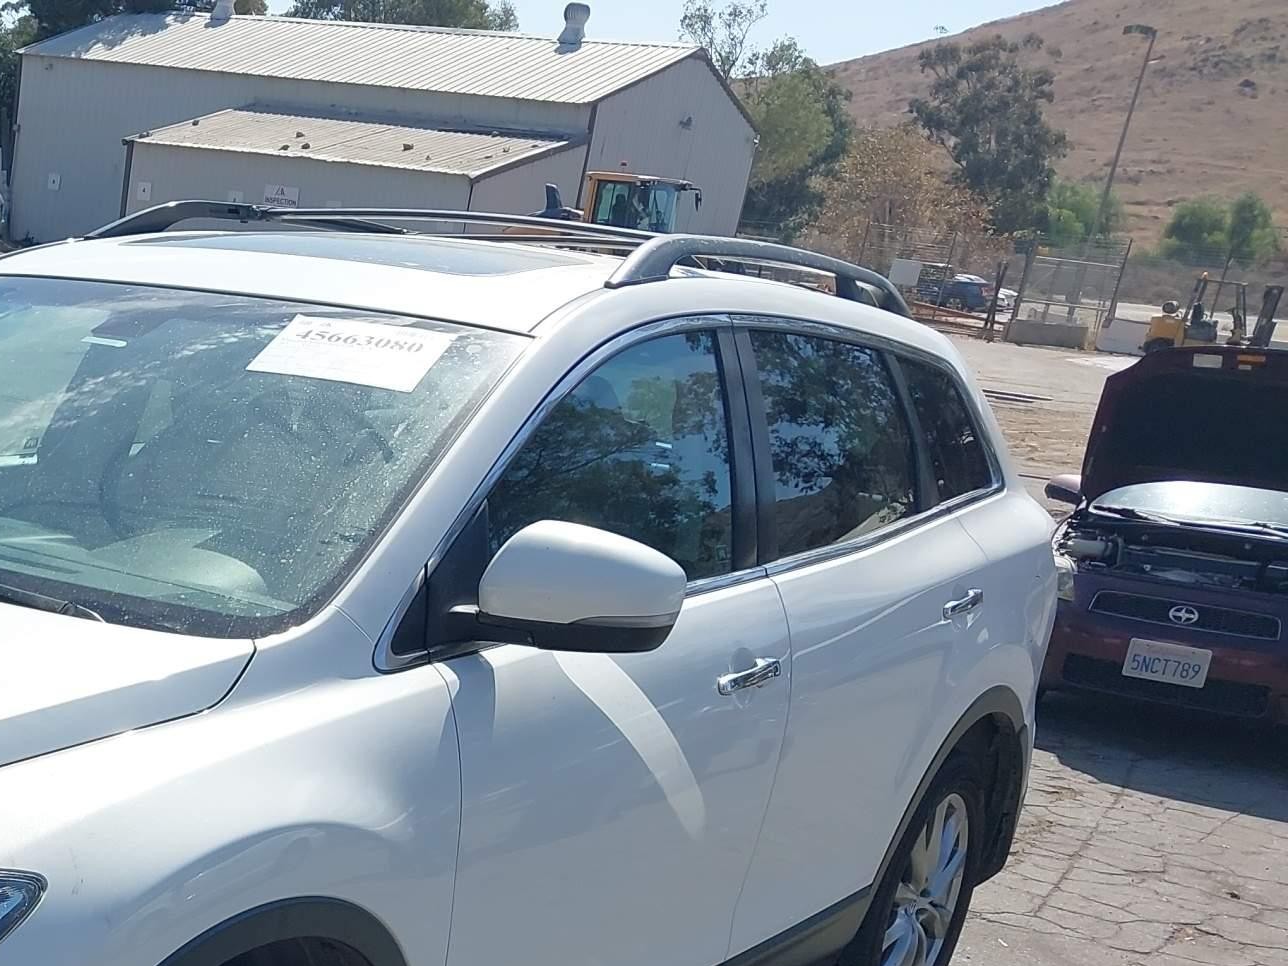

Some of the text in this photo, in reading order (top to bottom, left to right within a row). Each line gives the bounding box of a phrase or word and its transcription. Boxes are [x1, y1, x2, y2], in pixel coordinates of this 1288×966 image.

[264, 196, 297, 206] INSPECTION
[295, 329, 424, 353] 45663080
[1130, 653, 1202, 680] 5NCT789
